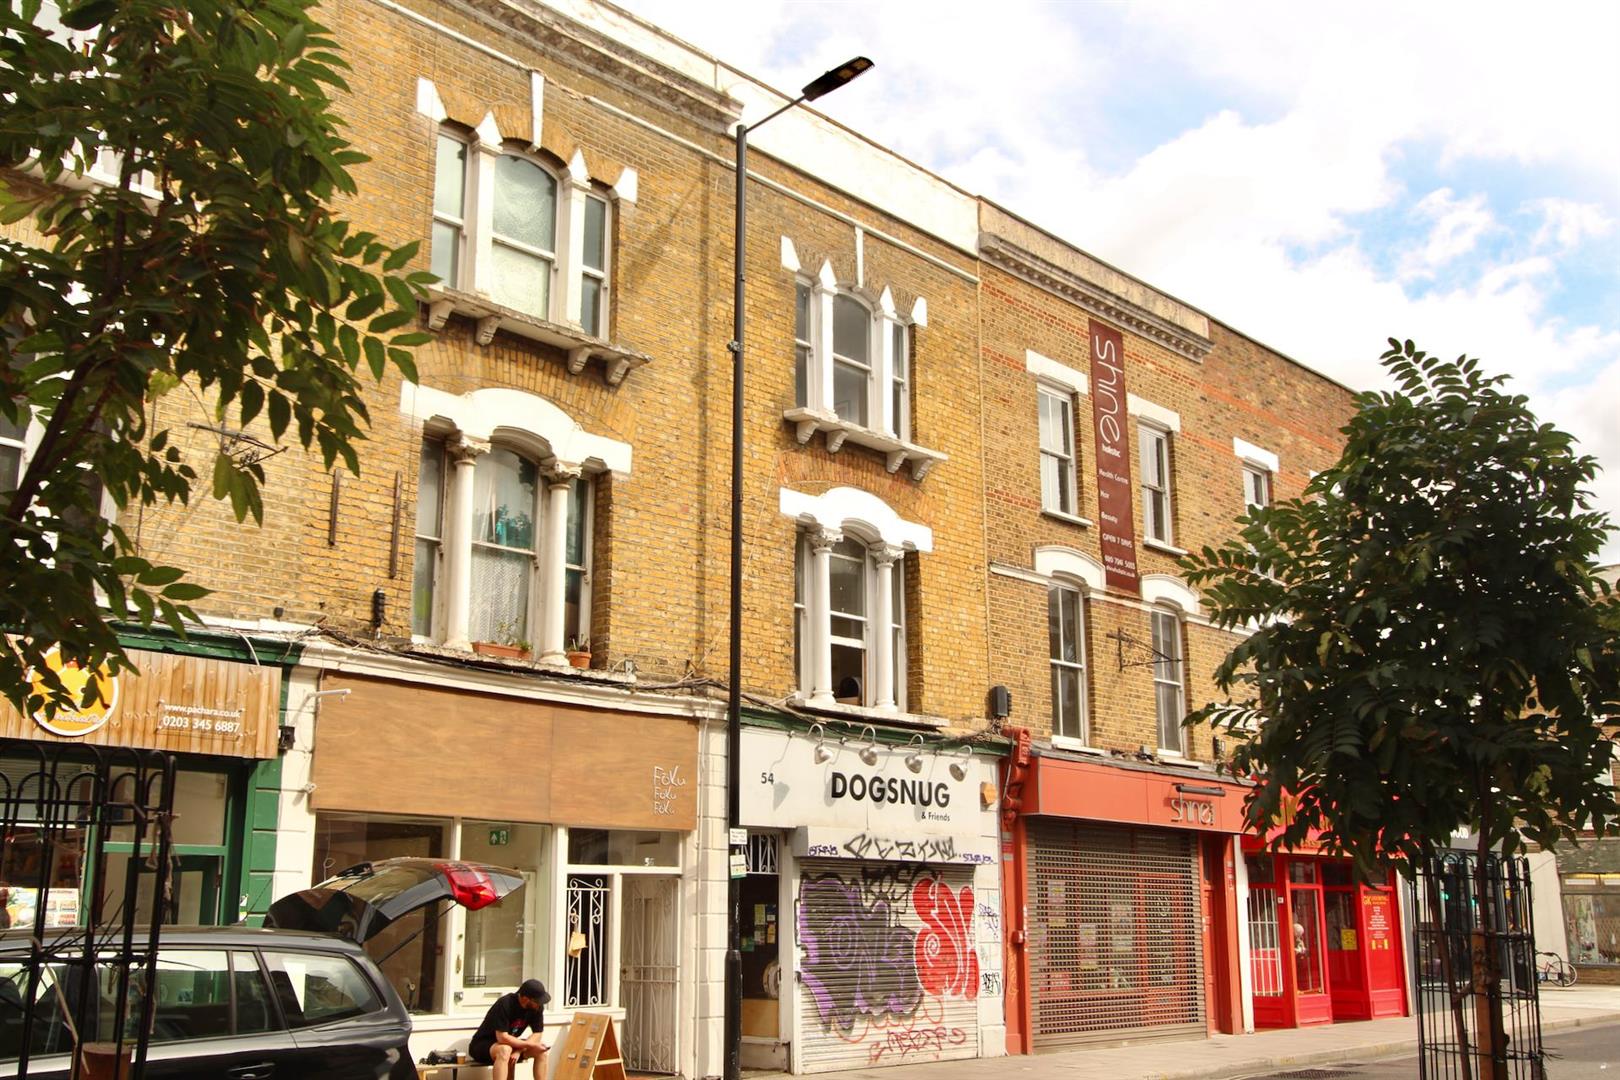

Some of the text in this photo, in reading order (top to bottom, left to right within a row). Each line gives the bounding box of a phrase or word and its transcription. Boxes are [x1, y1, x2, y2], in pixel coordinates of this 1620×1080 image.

[1102, 533, 1116, 543] OPEN
[164, 704, 241, 717] www.pachara.co.uk
[162, 715, 241, 733] 0203 345 6887
[760, 772, 775, 785] 54
[831, 771, 951, 808] DOGSNUG
[921, 811, 951, 822] & Friends
